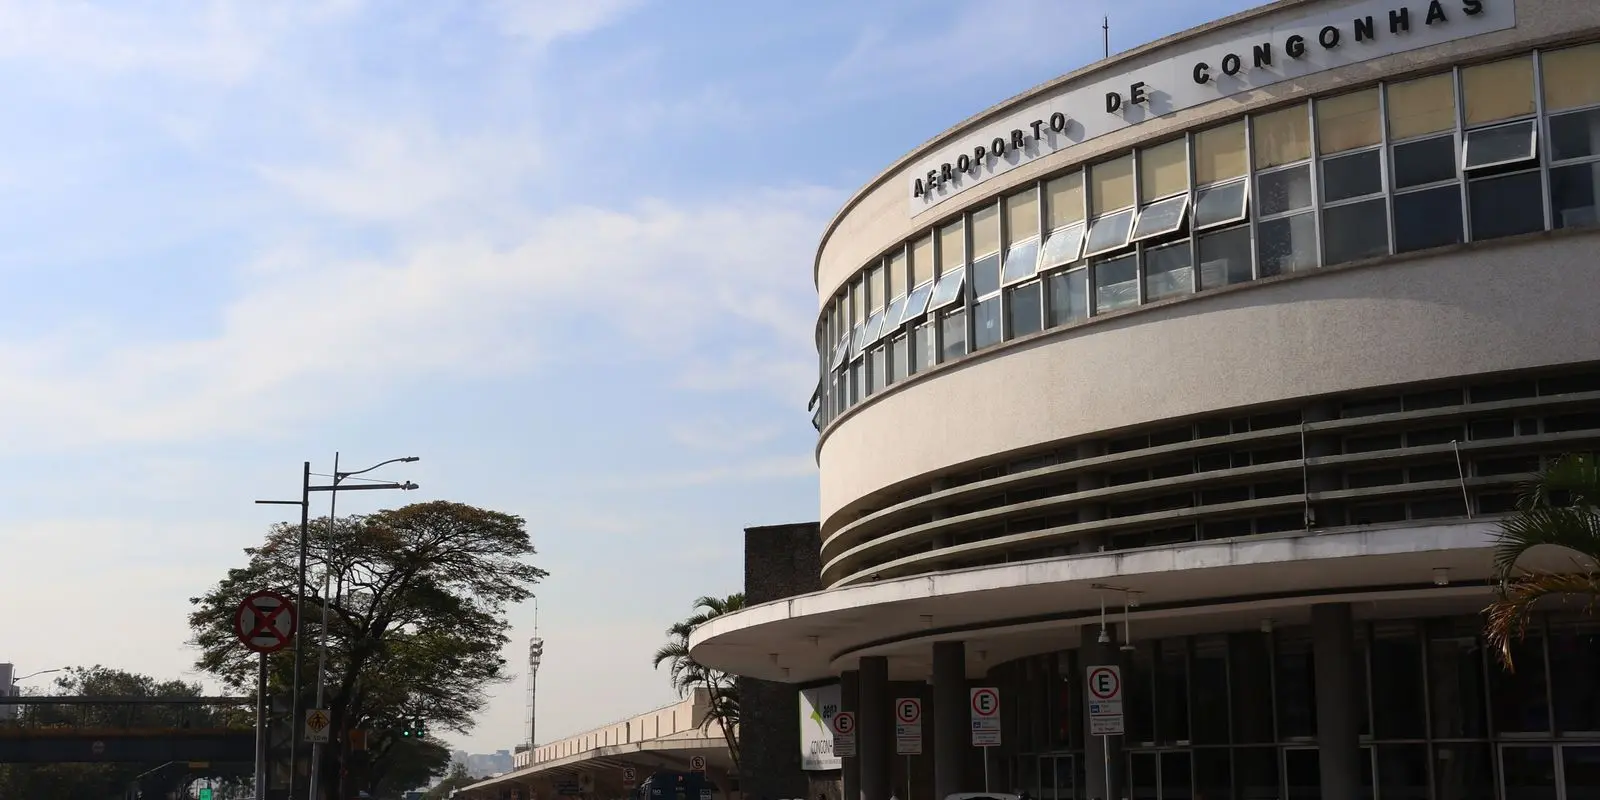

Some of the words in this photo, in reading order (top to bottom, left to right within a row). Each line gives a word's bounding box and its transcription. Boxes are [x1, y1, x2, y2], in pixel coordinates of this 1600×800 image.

[913, 112, 1065, 198] AEROPORTO
[1106, 81, 1145, 113] DE
[1193, 0, 1483, 84] CONGONHAS
[1098, 674, 1110, 692] E
[980, 694, 990, 710] E
[904, 704, 913, 718] E
[840, 717, 848, 730] E
